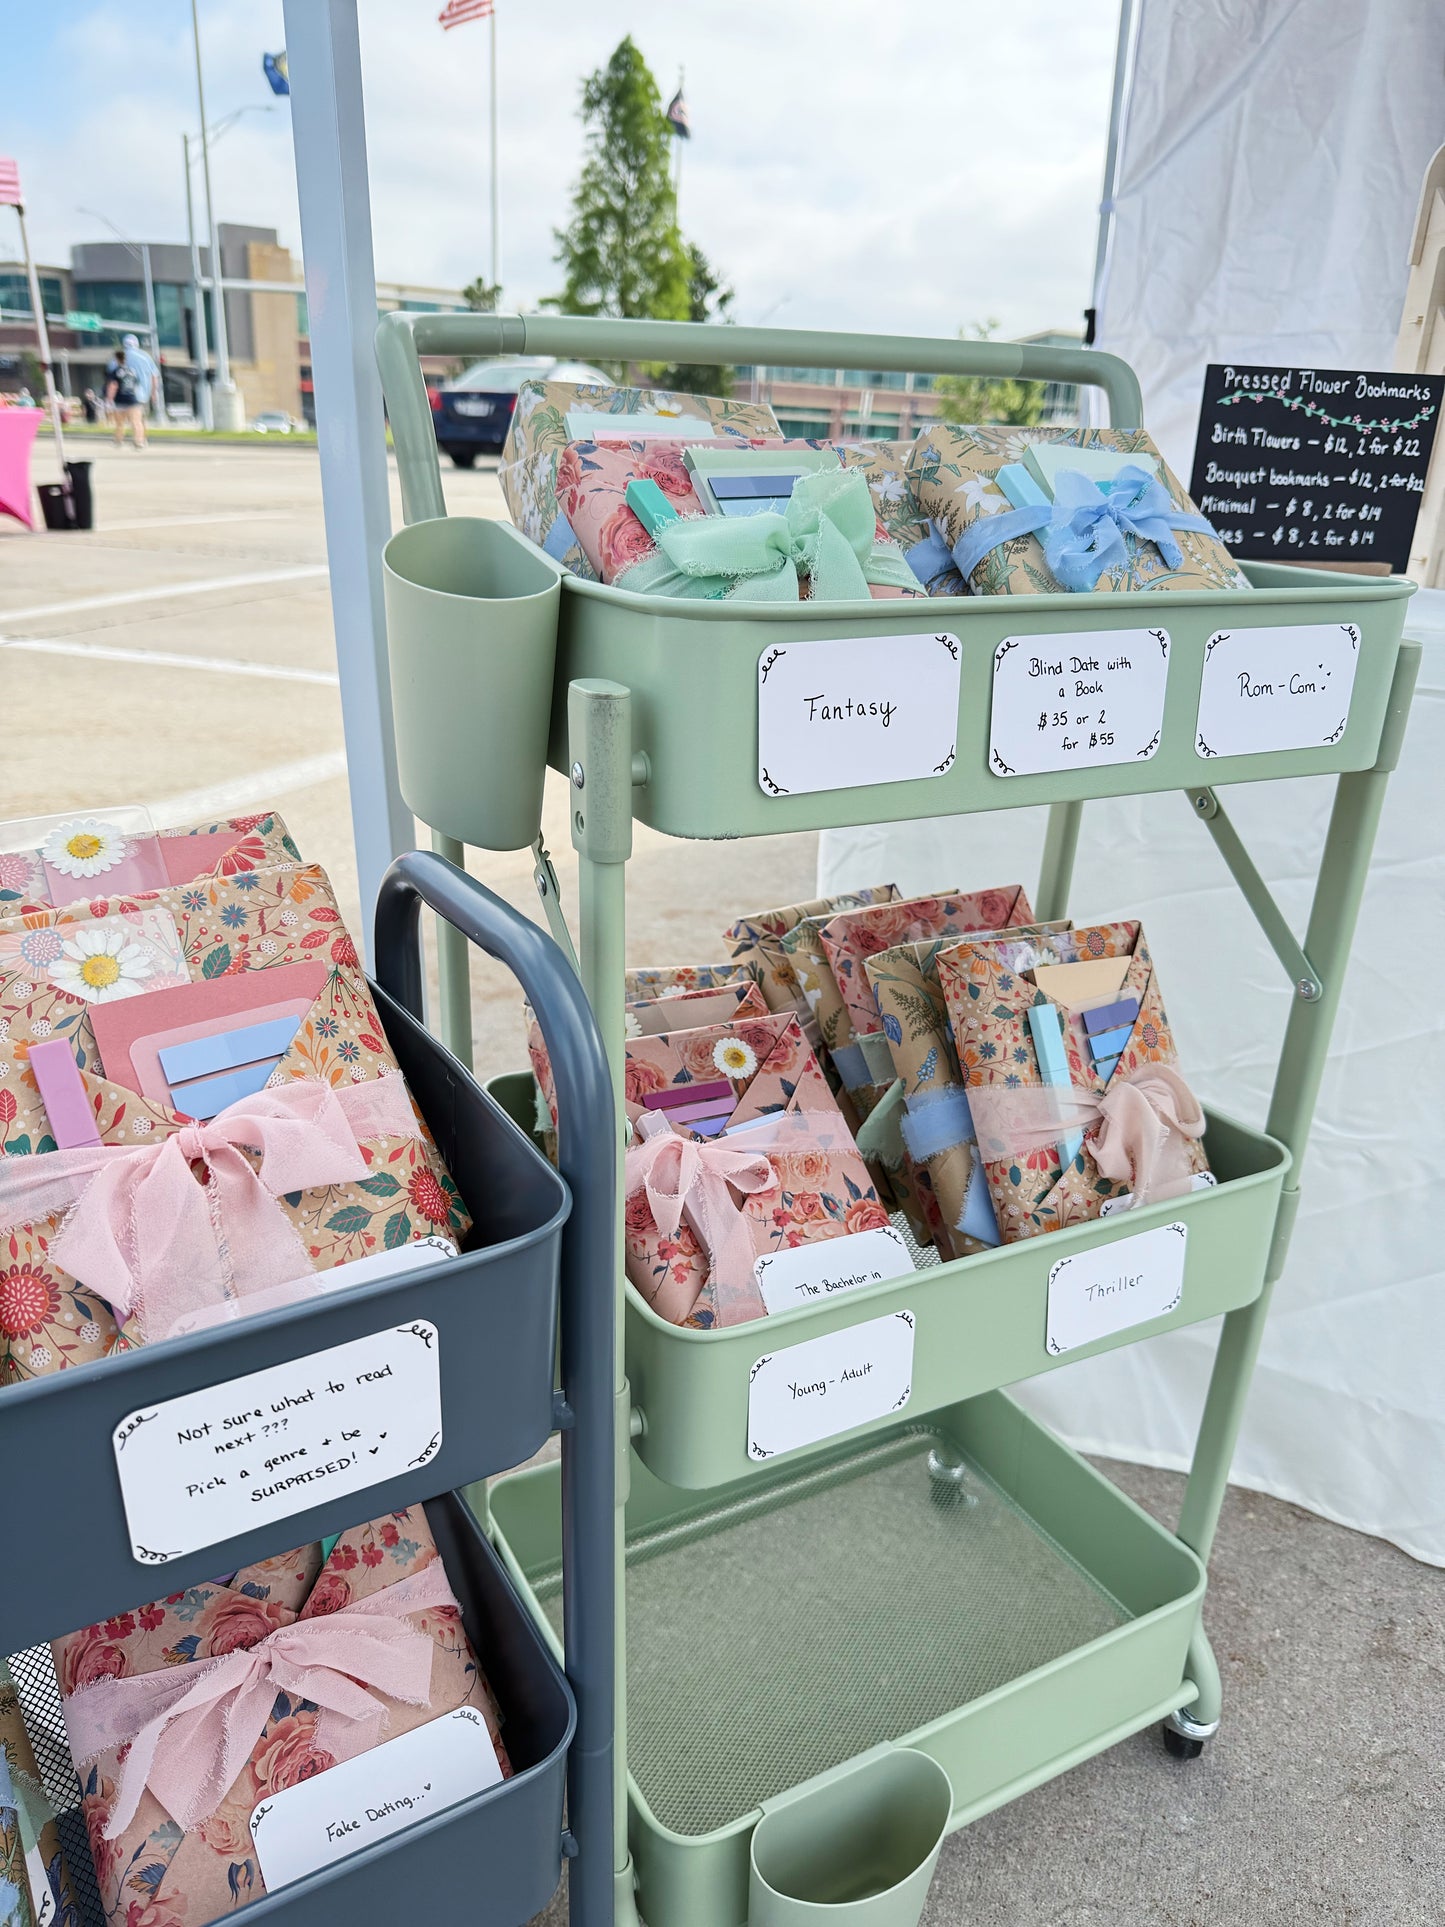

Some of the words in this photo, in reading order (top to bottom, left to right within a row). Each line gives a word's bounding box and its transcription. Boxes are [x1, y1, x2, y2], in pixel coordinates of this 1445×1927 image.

[1224, 367, 1291, 391] Pressed
[1299, 370, 1351, 394] Flower
[1355, 375, 1432, 400] Bookmarks
[1211, 423, 1247, 445] Birth
[1251, 428, 1300, 450] Flowers
[1369, 437, 1389, 455] for
[1392, 432, 1420, 456] $22
[1206, 462, 1266, 489] Bouquet
[1270, 469, 1329, 487] bookmarks
[1389, 473, 1407, 486] for
[1200, 496, 1256, 515] Minimal
[1336, 503, 1356, 517] for
[1359, 504, 1382, 521] $14
[1324, 530, 1344, 545] for
[1028, 658, 1062, 677] Blind
[1069, 656, 1099, 673] Date
[1108, 657, 1131, 670] with
[1059, 688, 1065, 697] a
[1075, 681, 1103, 697] Book
[804, 695, 897, 727] Fantasy
[1076, 716, 1089, 724] or
[1098, 710, 1106, 724] 2
[1061, 737, 1079, 750] for
[1089, 732, 1114, 749] $55
[795, 1283, 820, 1296] The
[822, 1275, 867, 1292] Bachelor
[871, 1271, 881, 1279] in
[1085, 1275, 1143, 1301] Thriller
[178, 1423, 212, 1444] Not
[223, 1409, 263, 1430] sure
[271, 1389, 315, 1413] what
[325, 1381, 344, 1393] to
[356, 1364, 392, 1384] read
[215, 1432, 256, 1454] next
[261, 1418, 288, 1437] ???
[186, 1477, 226, 1497] Pick
[240, 1470, 250, 1478] a
[264, 1448, 308, 1471] genre
[341, 1430, 361, 1441] be
[250, 1452, 358, 1502] SURPRISED!
[326, 1821, 360, 1842] Fake
